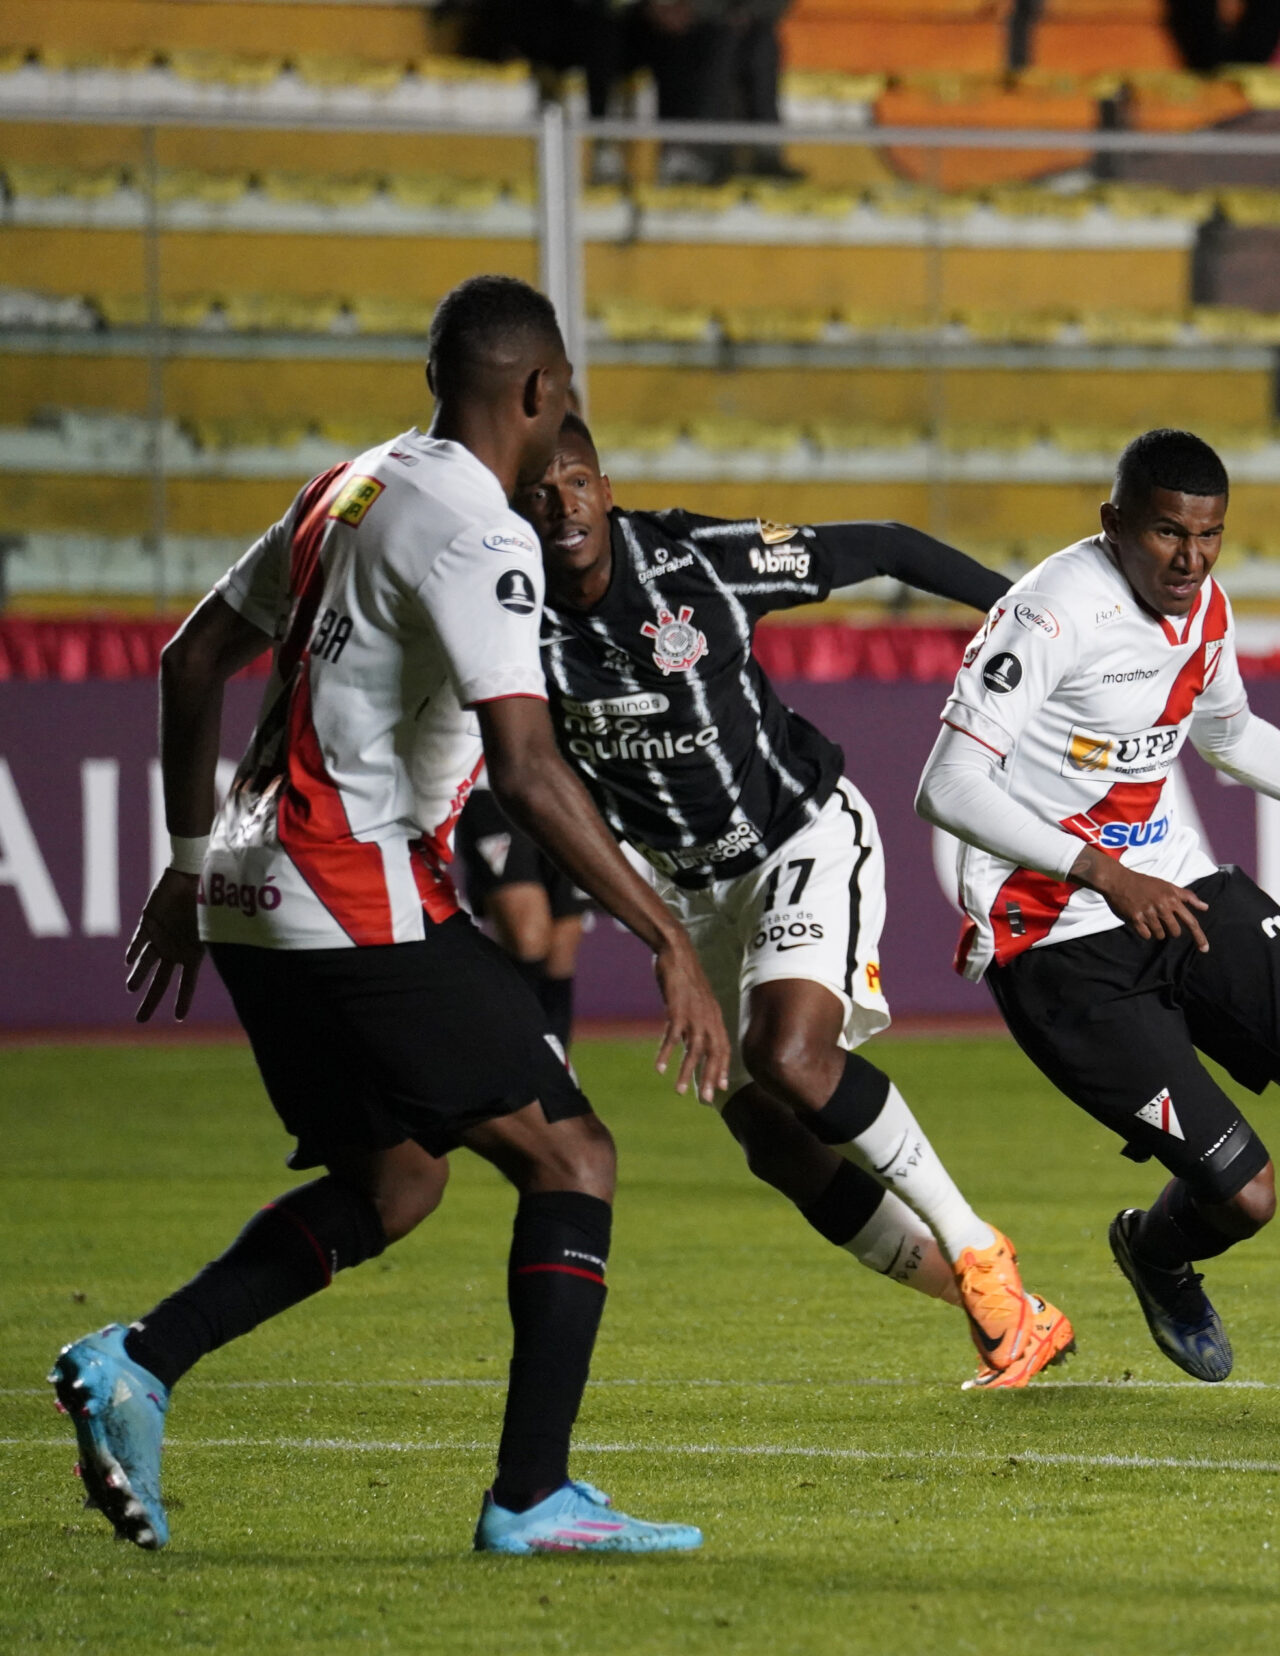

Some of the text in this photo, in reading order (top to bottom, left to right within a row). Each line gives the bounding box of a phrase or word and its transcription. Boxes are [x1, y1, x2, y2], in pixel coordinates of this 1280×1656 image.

[766, 551, 810, 579] bmg
[1019, 606, 1054, 634] Delizia
[1102, 668, 1160, 684] marathon
[564, 714, 642, 736] neo
[209, 872, 283, 918] Bagó
[764, 858, 816, 912] 17
[797, 911, 814, 920] de
[754, 922, 824, 949] ODOS
